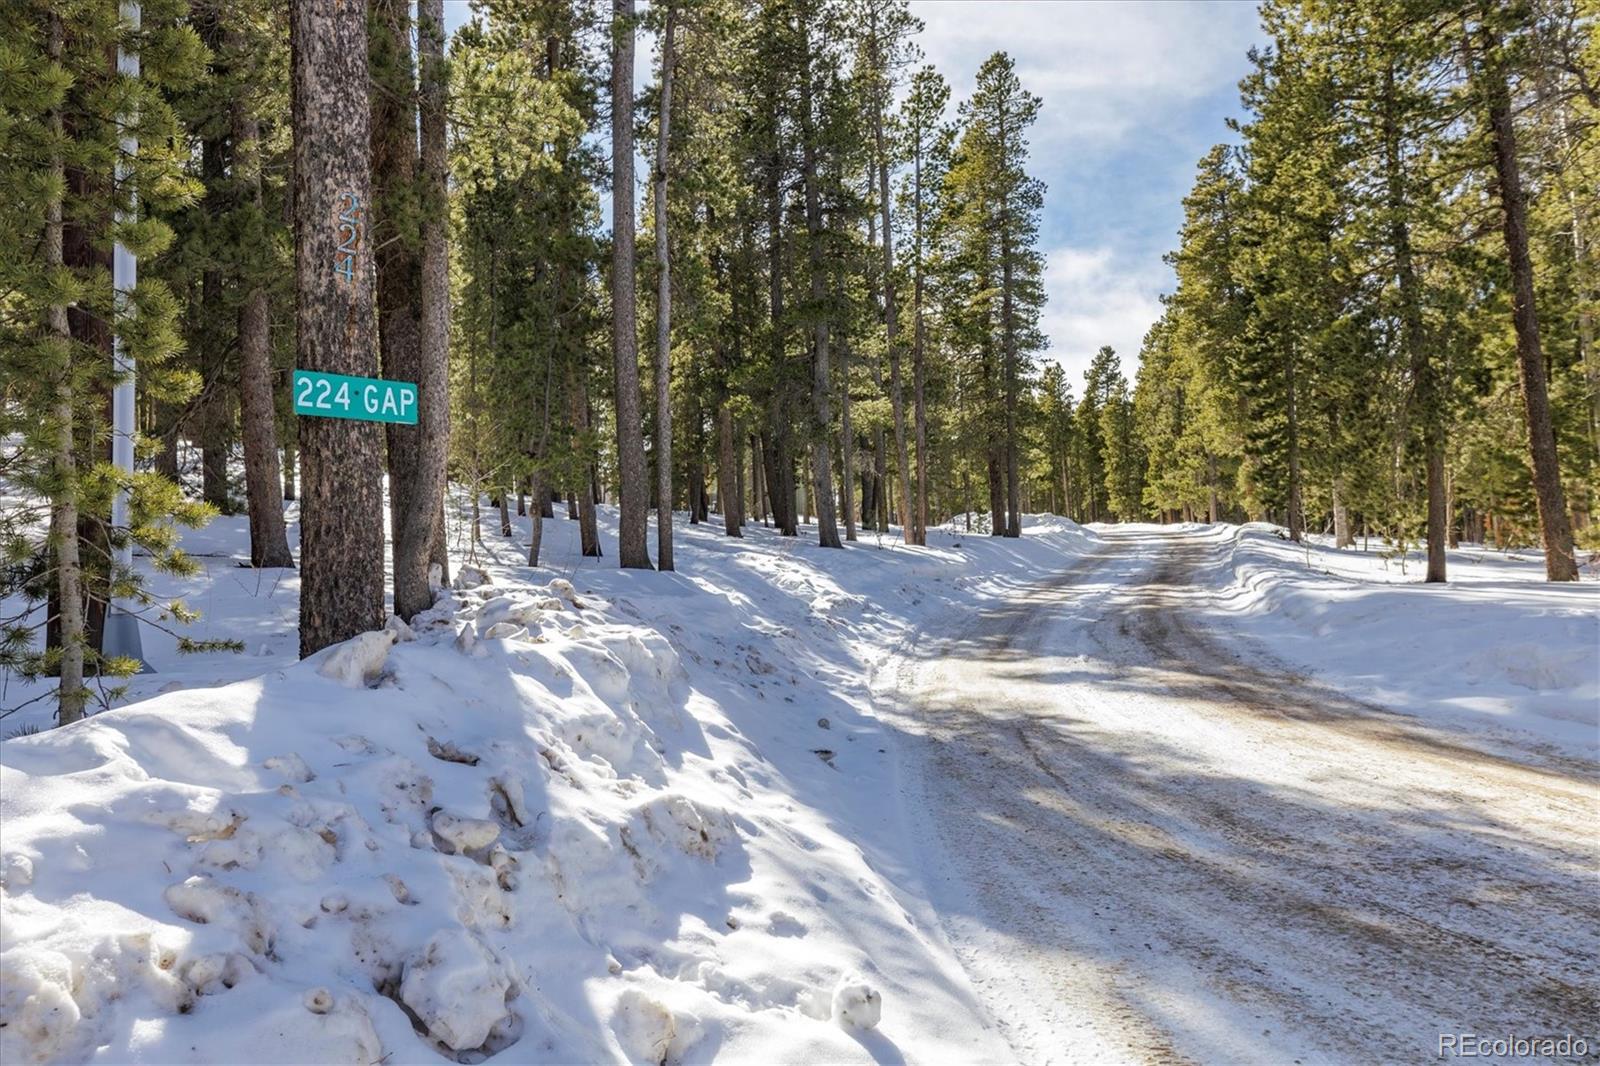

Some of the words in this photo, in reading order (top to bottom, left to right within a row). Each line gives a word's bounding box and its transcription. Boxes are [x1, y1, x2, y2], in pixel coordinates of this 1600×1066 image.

[334, 192, 359, 281] 224
[297, 377, 351, 411] 224
[364, 385, 414, 416] GAP
